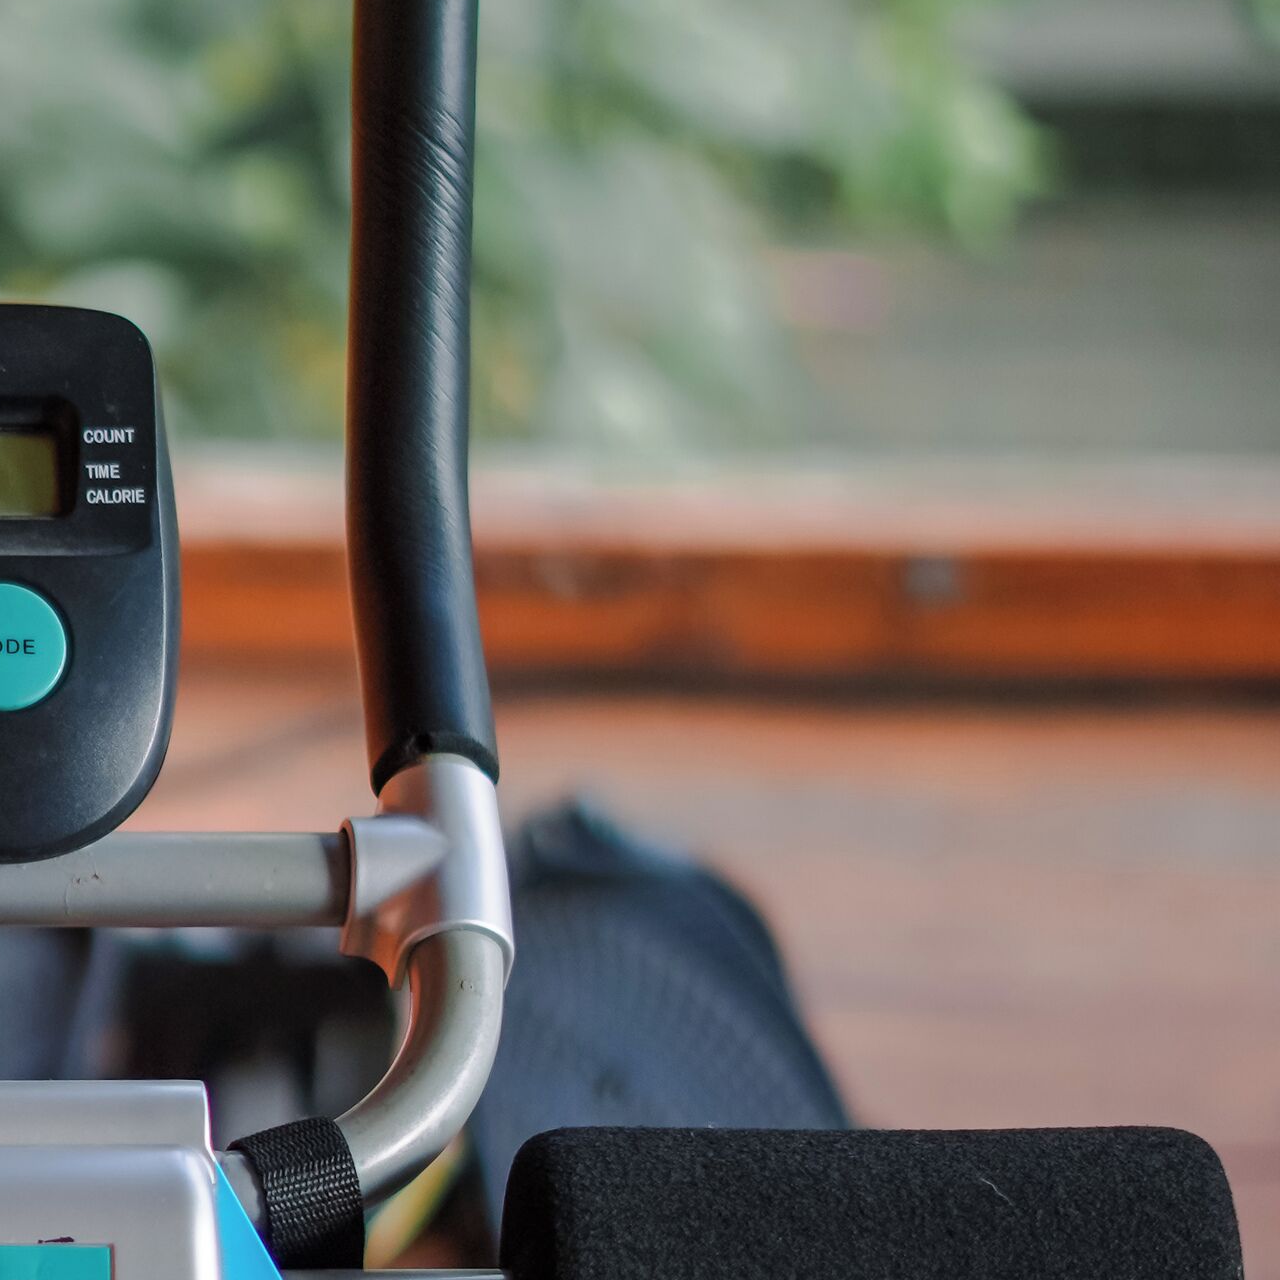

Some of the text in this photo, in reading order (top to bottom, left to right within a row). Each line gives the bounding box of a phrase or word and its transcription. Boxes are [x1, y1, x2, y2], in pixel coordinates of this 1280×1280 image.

[83, 428, 135, 444] COUNT
[85, 464, 120, 479] TIME
[85, 488, 145, 504] CALORIE
